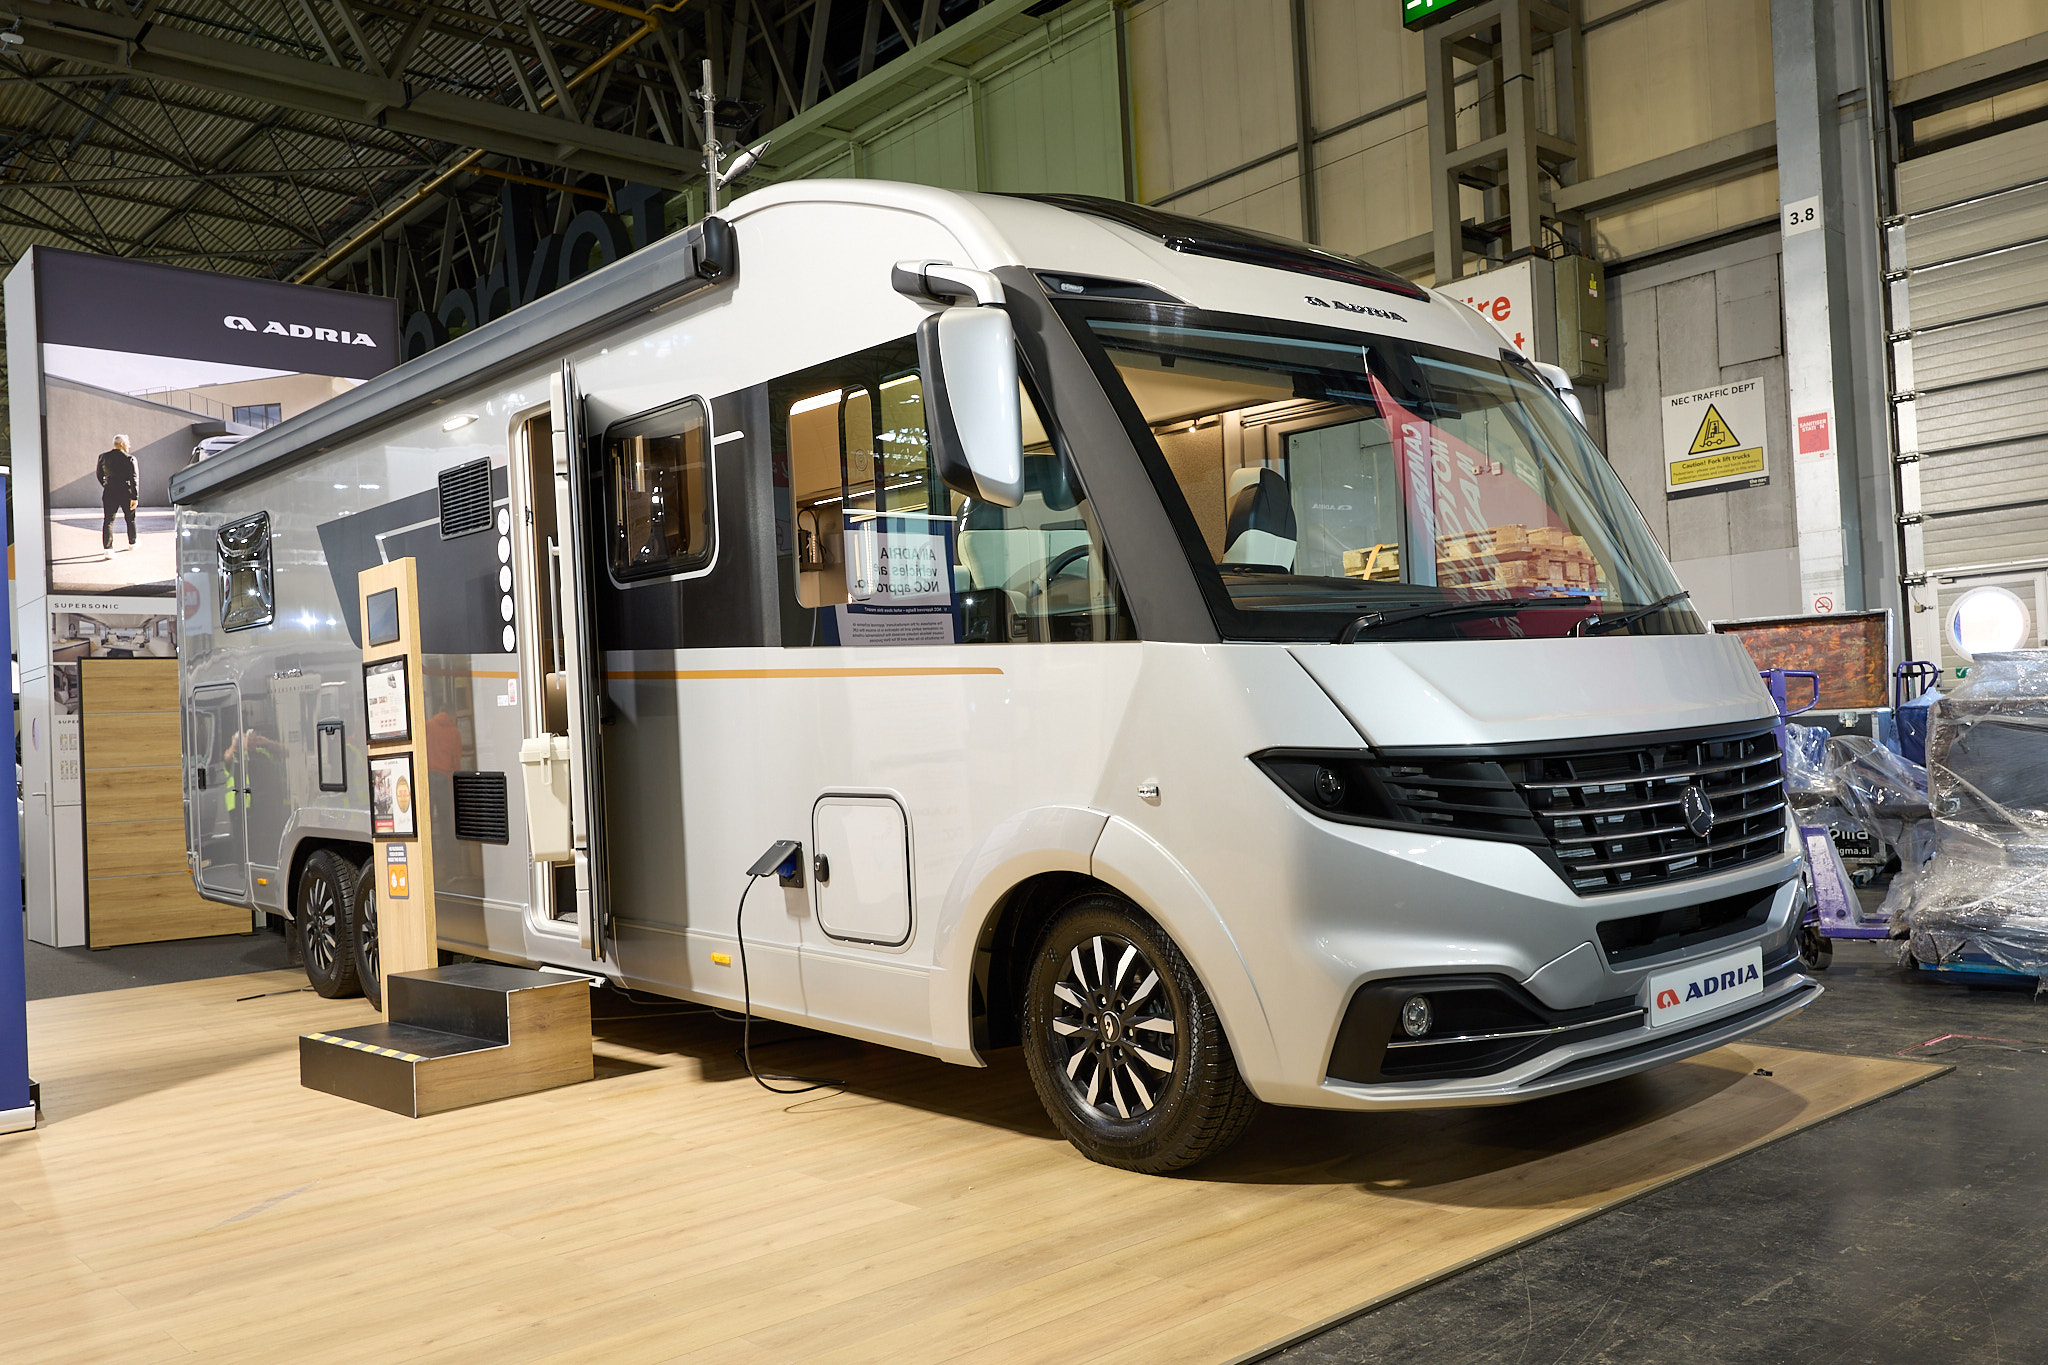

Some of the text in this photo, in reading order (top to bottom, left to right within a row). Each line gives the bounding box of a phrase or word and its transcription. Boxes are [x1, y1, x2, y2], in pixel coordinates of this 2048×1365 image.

[1790, 207, 1815, 226] 3.8
[262, 321, 377, 347] ADRIA
[1671, 382, 1755, 407] NEC TRAFFIC DEPT
[1682, 461, 1706, 470] Caution!
[1733, 453, 1750, 461] trucks
[54, 602, 119, 610] SUPERSONIC
[1685, 963, 1759, 1002] ADRIA
